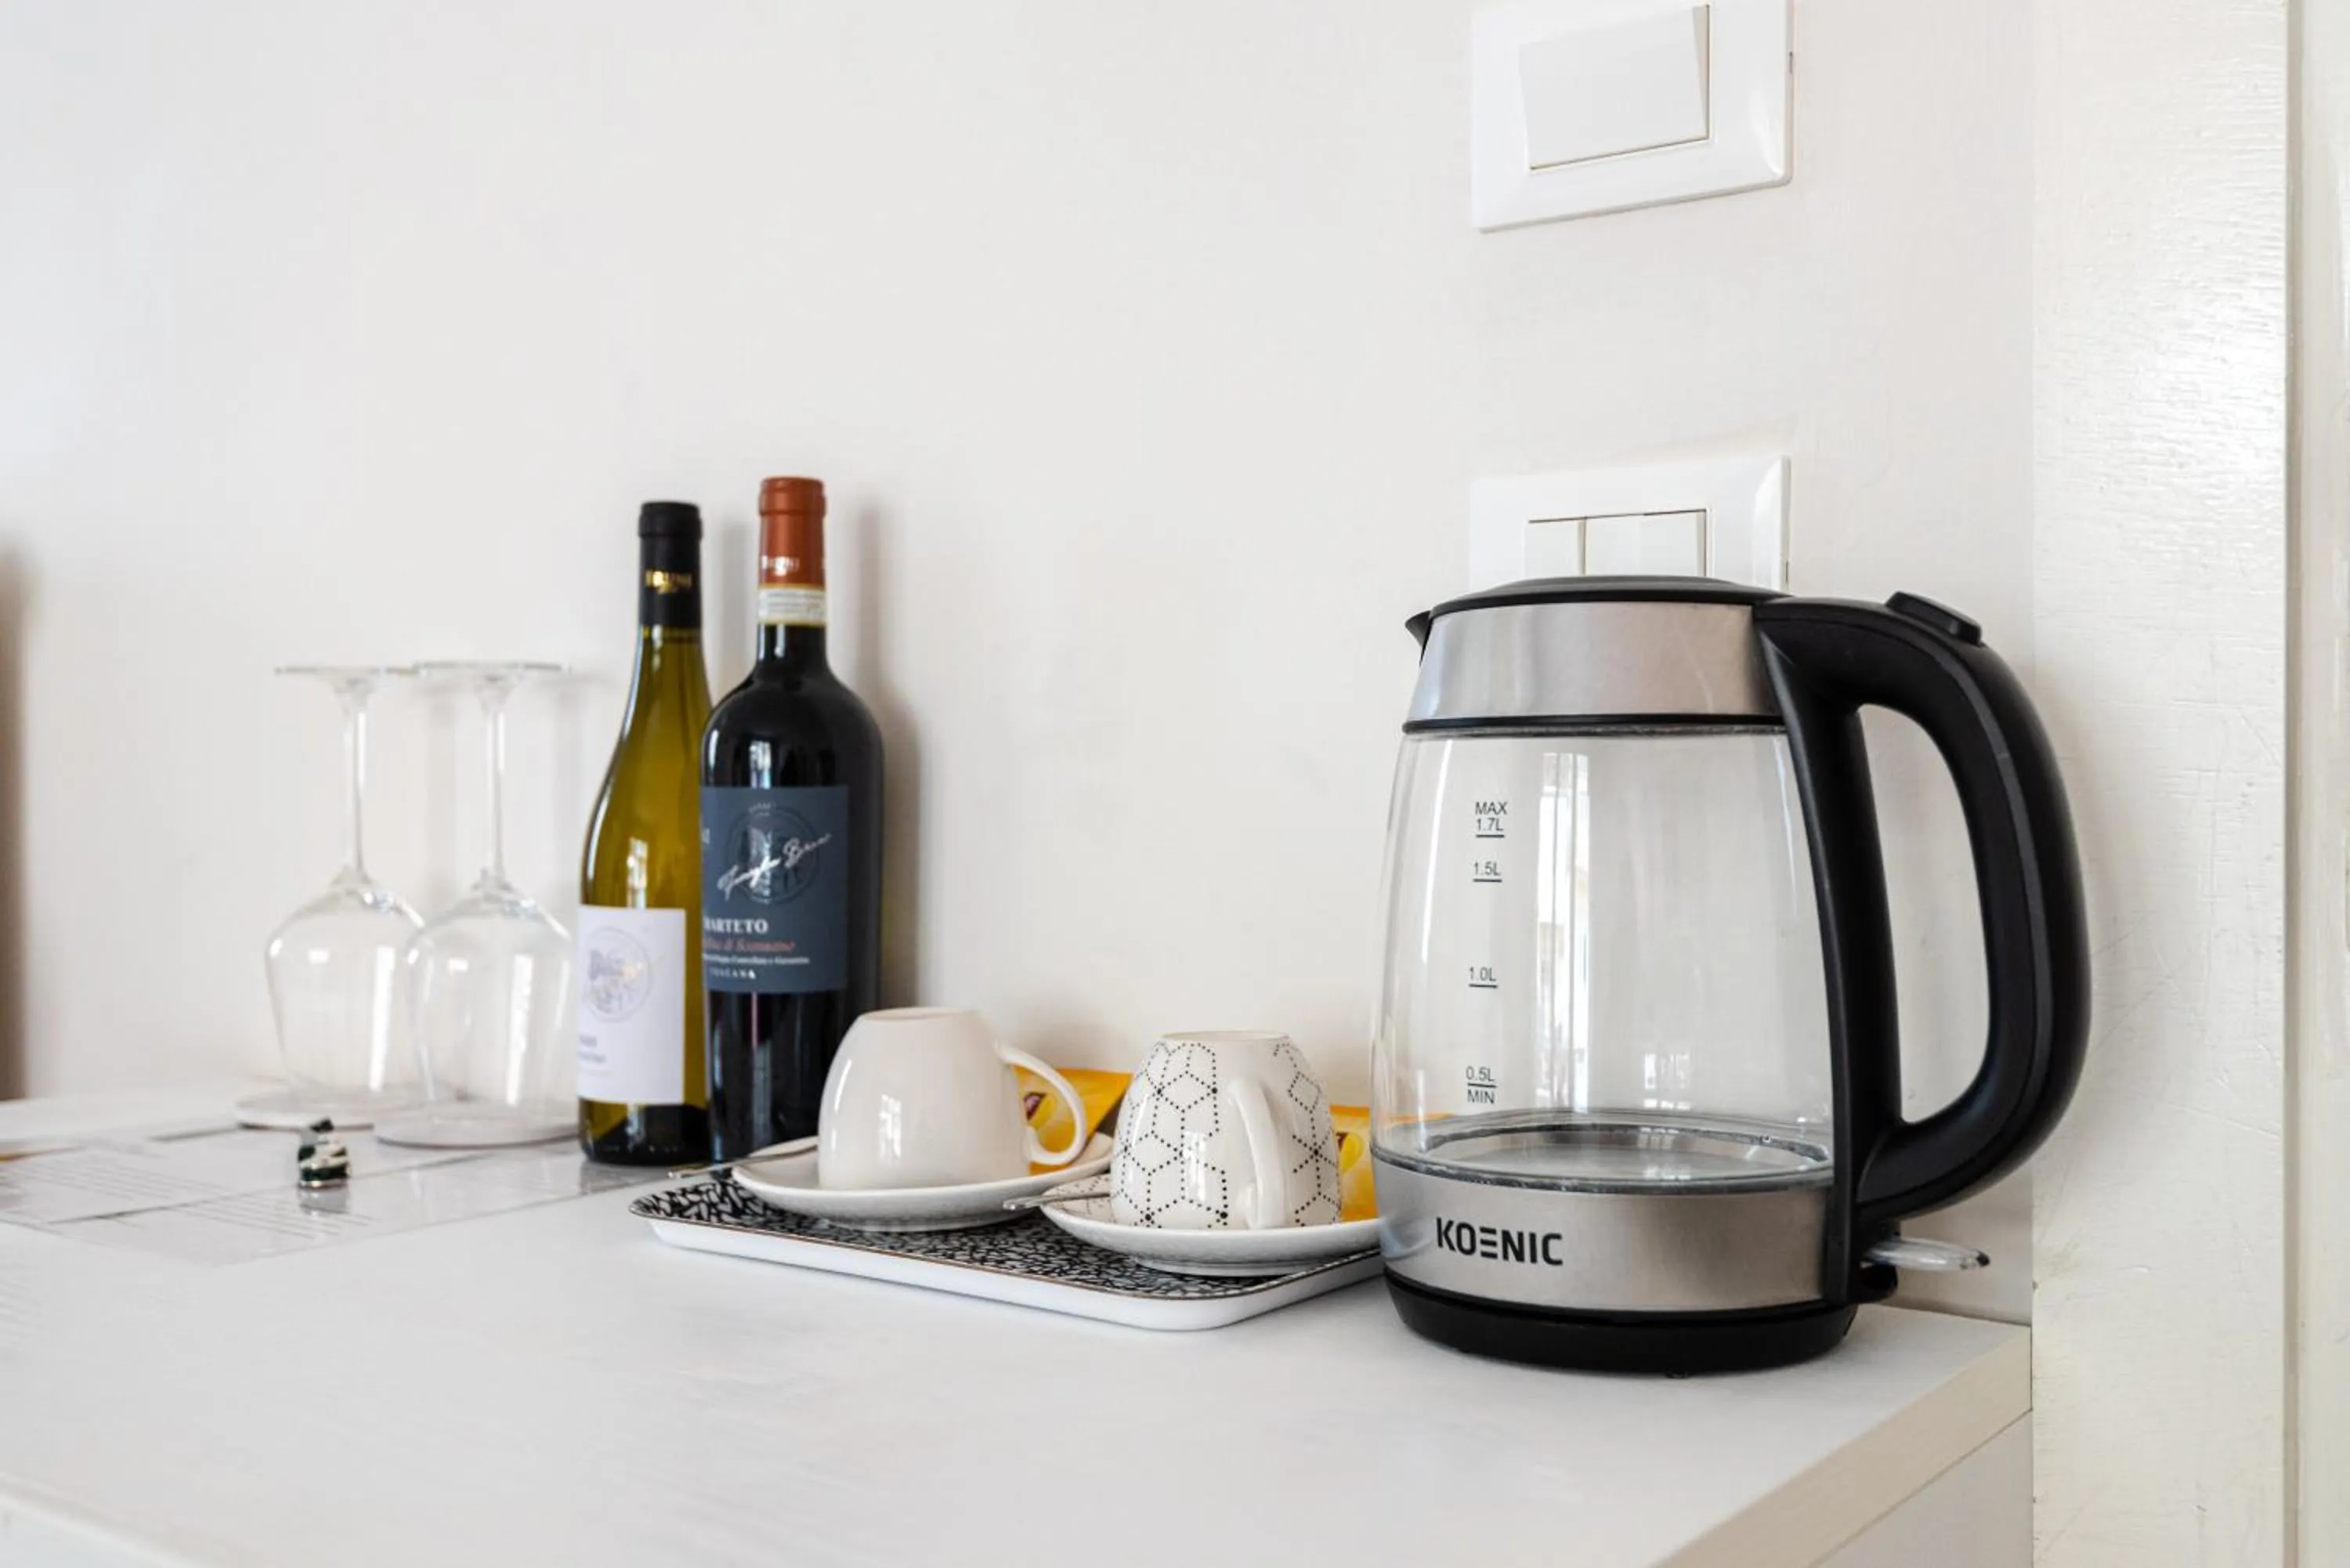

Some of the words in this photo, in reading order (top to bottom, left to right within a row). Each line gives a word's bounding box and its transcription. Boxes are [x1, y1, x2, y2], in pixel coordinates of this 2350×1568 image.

[1475, 801, 1508, 815] MAX
[1477, 817, 1504, 831] 1.7L
[1474, 861, 1502, 876] 1.5L
[1469, 966, 1497, 981] 1.0L
[1466, 1066, 1495, 1082] 0.5L
[1467, 1089, 1495, 1104] MIN
[1436, 1216, 1564, 1266] KOENIC
